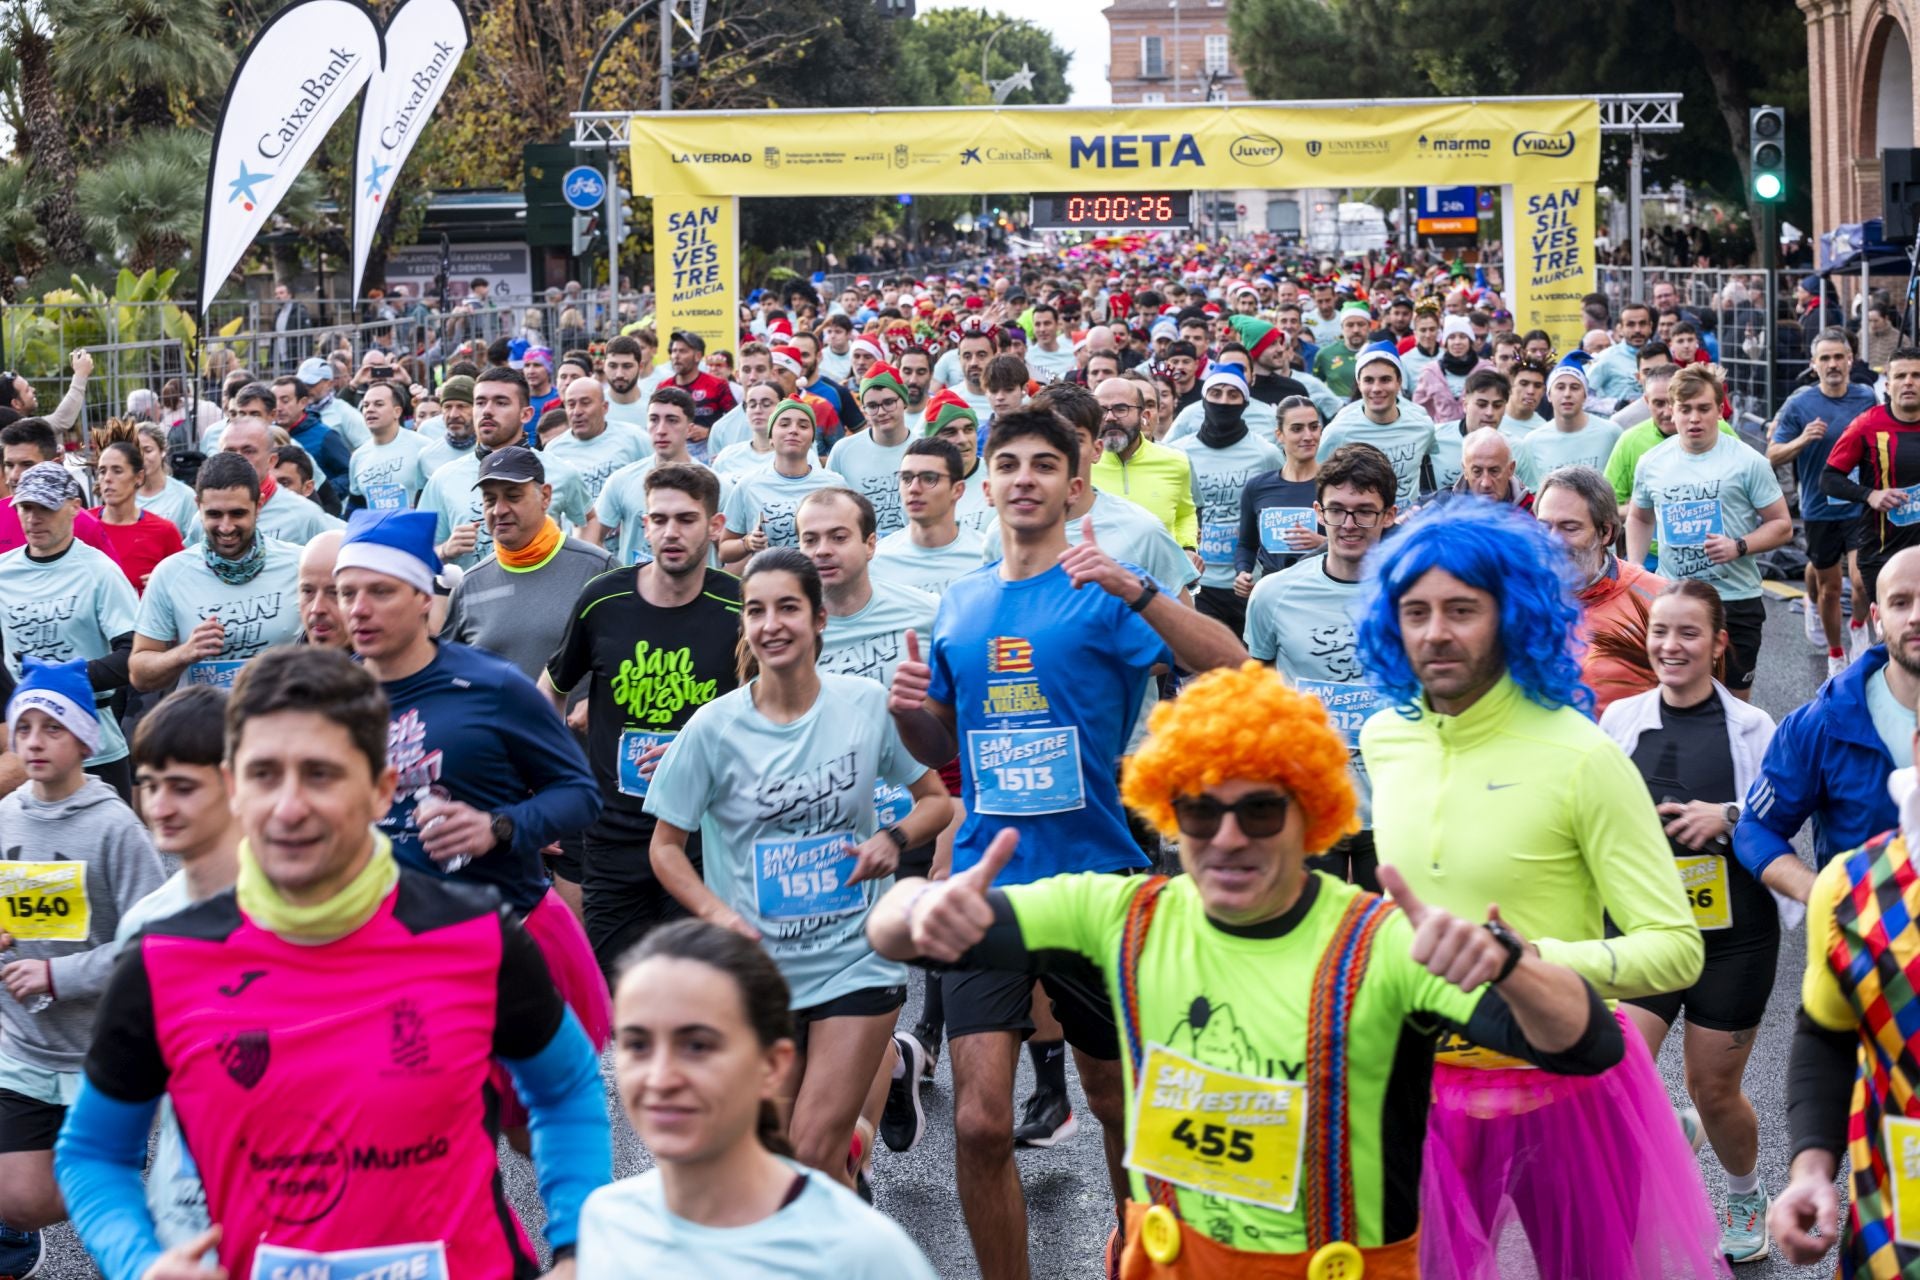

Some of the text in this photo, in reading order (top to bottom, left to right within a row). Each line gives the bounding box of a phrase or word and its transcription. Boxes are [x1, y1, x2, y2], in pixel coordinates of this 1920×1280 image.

[257, 47, 357, 159] CaixaBank
[380, 40, 454, 150] CaixaBank
[986, 146, 1054, 161] CaixaBank
[1070, 133, 1206, 169] META
[1235, 144, 1277, 157] Juver
[1433, 138, 1491, 151] marmo
[1522, 138, 1567, 150] VIDAL
[671, 152, 753, 164] LA VERDAD
[1068, 196, 1173, 222] 0:00:26
[1527, 187, 1581, 215] SAN
[668, 206, 719, 232] SAN
[1535, 209, 1573, 234] SIL
[676, 227, 712, 250] SIL
[1532, 227, 1578, 253] VES
[672, 244, 718, 270] VES
[1532, 247, 1580, 273] TRE
[673, 264, 720, 289] TRE
[1531, 266, 1584, 286] MURCIA
[672, 282, 725, 303] MURCIA
[1544, 293, 1582, 301] VERDAD
[685, 309, 723, 317] VERDAD
[1666, 501, 1717, 524] SILVESTRE
[1671, 519, 1713, 535] 2877
[629, 639, 695, 681] San
[646, 708, 673, 724] 20
[629, 737, 659, 750] SAN
[979, 736, 1013, 756] SAN
[980, 733, 1069, 771] SILVESTRE
[1028, 749, 1068, 767] MURCIA
[756, 751, 858, 822] SAN
[993, 766, 1055, 792] 1513
[763, 843, 797, 863] SAN
[763, 836, 850, 881] SILVESTRE
[778, 868, 839, 898] 1515
[6, 896, 70, 918] 1540
[1156, 1065, 1206, 1092] SAN
[1151, 1087, 1293, 1113] SILVESTRE
[352, 1135, 449, 1170] Murcia
[1171, 1117, 1255, 1164] 455
